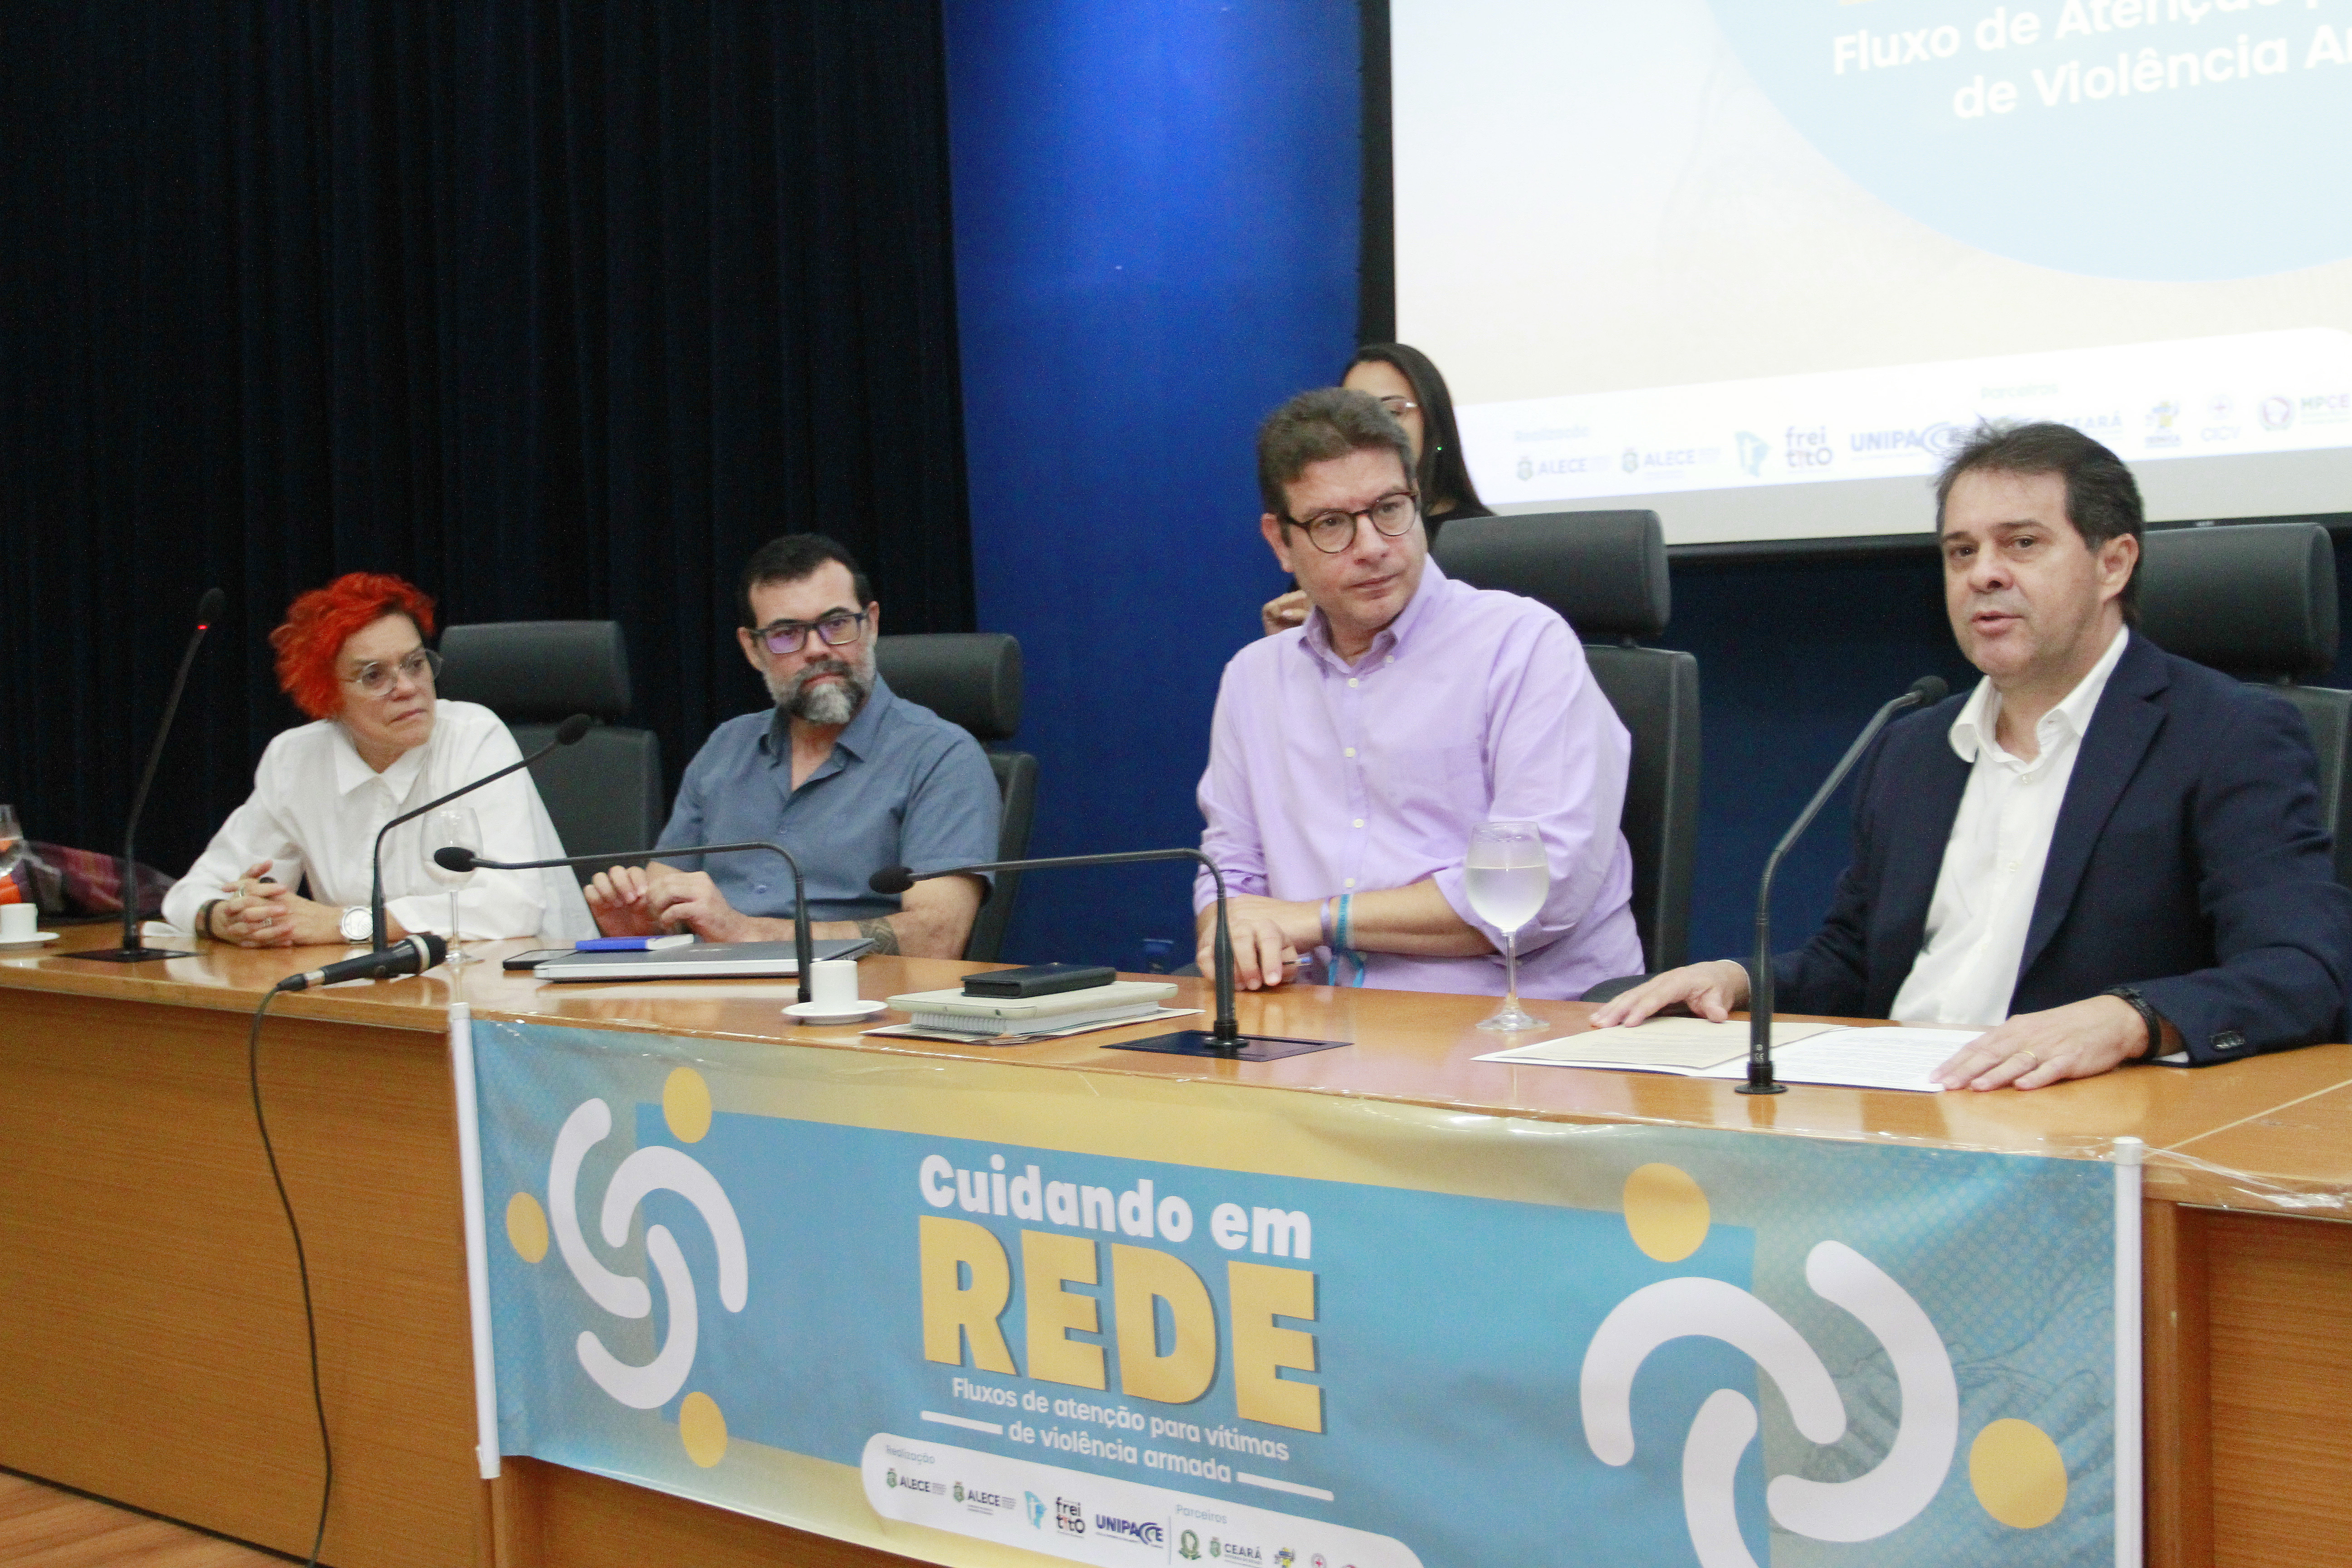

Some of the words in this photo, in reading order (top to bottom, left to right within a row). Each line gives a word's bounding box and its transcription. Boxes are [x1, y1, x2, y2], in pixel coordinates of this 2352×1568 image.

[1833, 24, 1960, 75] Fluxo
[1975, 6, 2041, 51] de
[2054, 0, 2284, 39] Atenç
[1953, 74, 2018, 119] de
[2032, 34, 2288, 107] Violência
[1786, 426, 1827, 446] frei
[1538, 458, 1587, 475] ALECE
[1643, 449, 1695, 467] ALECE
[919, 1154, 1193, 1242] Cuidando
[1210, 1201, 1311, 1259] em
[919, 1214, 1325, 1433] REDE
[953, 1377, 1018, 1407] Fluxos
[1022, 1390, 1049, 1413] de
[1053, 1398, 1145, 1431] atenção
[1149, 1416, 1200, 1443] para
[1204, 1425, 1289, 1461] vítimas
[1008, 1421, 1035, 1444] de
[1040, 1426, 1137, 1465] violência
[1143, 1449, 1231, 1483] armada
[899, 1475, 931, 1493] ALECE
[967, 1489, 1001, 1507] ALECE
[1055, 1496, 1081, 1517] frei
[1176, 1504, 1228, 1524] Parceiros
[1224, 1543, 1263, 1560] CEARÁ
